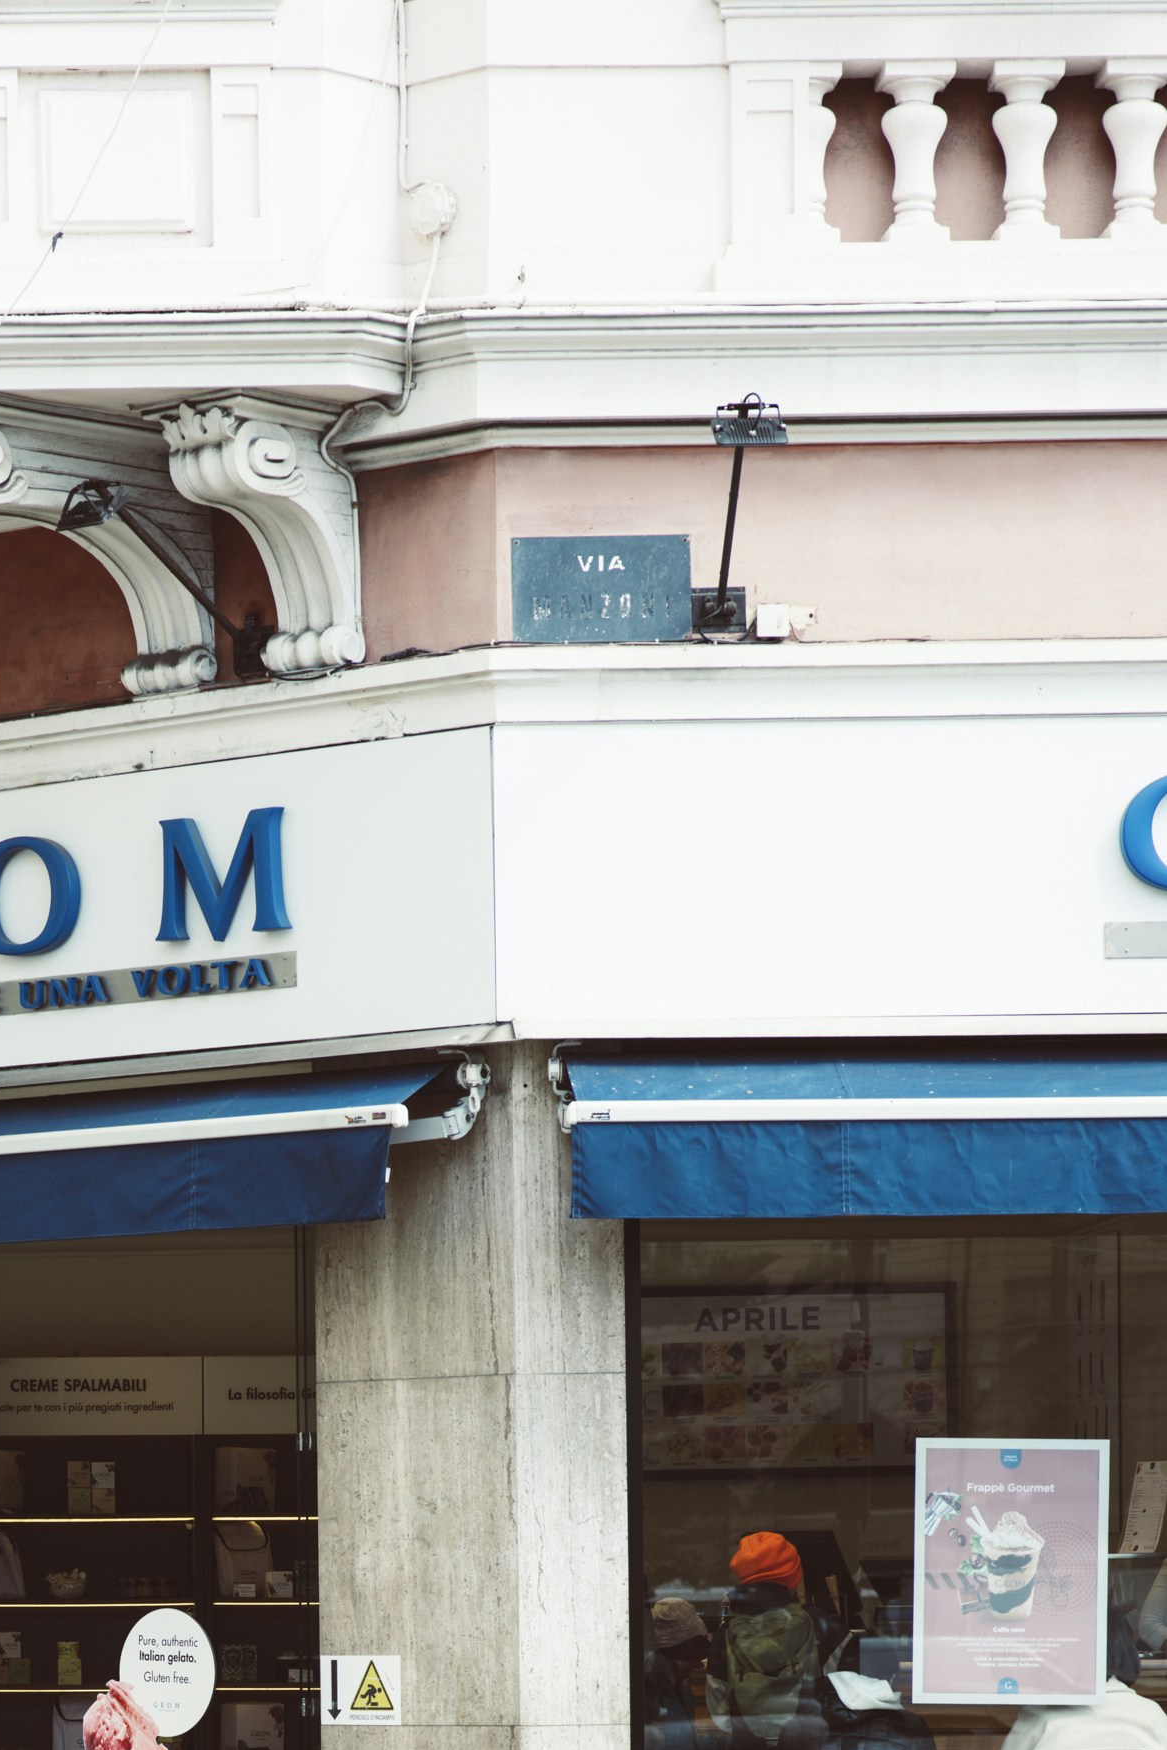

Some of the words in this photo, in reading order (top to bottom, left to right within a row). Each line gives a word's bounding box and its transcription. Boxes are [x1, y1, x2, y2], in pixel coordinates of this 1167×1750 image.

[577, 555, 625, 572] VIA
[19, 975, 108, 1010] UNA
[131, 958, 271, 998] VOLTA
[695, 1306, 820, 1332] APRILE
[10, 1378, 59, 1392] CREME
[64, 1378, 147, 1392] SPALMABILI
[228, 1388, 242, 1400] La
[246, 1387, 295, 1400] filosofia
[16, 1404, 32, 1414] per
[34, 1403, 43, 1412] te
[44, 1404, 61, 1412] con
[68, 1402, 84, 1414] più
[85, 1402, 122, 1414] pregiati
[124, 1401, 174, 1414] ingredienti
[966, 1482, 1005, 1494] Frappè
[1007, 1482, 1055, 1493] Gourmet
[995, 1579, 1026, 1590] GROM
[138, 1634, 159, 1648] Pure,
[161, 1635, 199, 1648] authentic
[139, 1650, 166, 1662] Italian
[167, 1651, 197, 1665] gelato.
[143, 1670, 171, 1683] Gluten
[173, 1670, 192, 1684] free.
[1004, 1681, 1012, 1690] G
[153, 1701, 180, 1709] GROM
